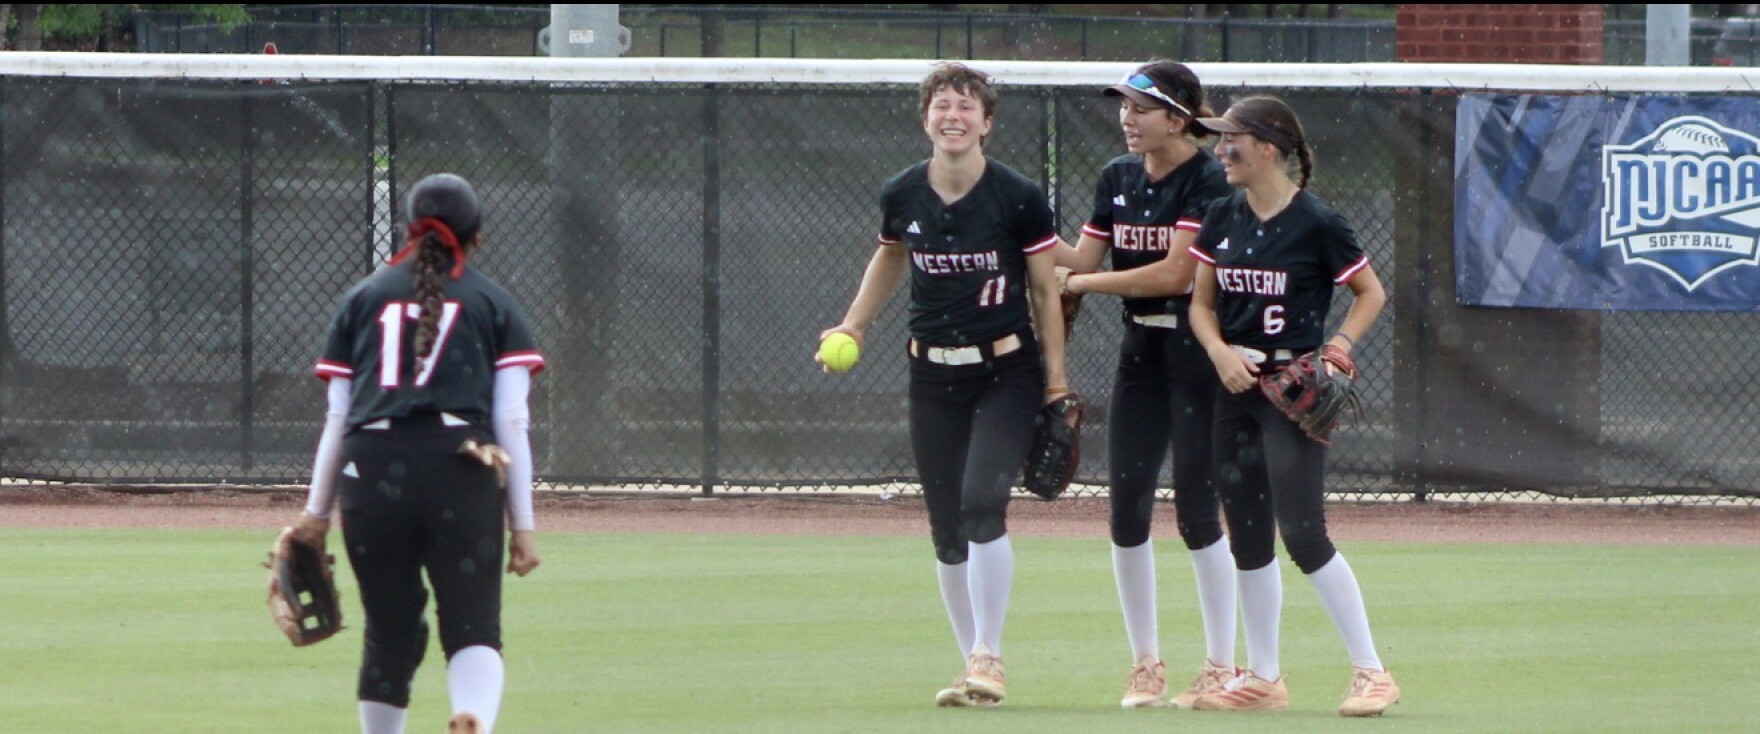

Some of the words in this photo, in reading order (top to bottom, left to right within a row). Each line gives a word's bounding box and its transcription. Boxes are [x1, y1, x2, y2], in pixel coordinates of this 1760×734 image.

[1617, 159, 1760, 228] NJCAA
[1648, 234, 1733, 250] SOFTBALL
[912, 250, 999, 274] WESTERN
[979, 274, 1006, 306] 11
[1216, 267, 1288, 296] WESTERN
[1263, 304, 1286, 335] 6
[378, 300, 461, 388] 17
